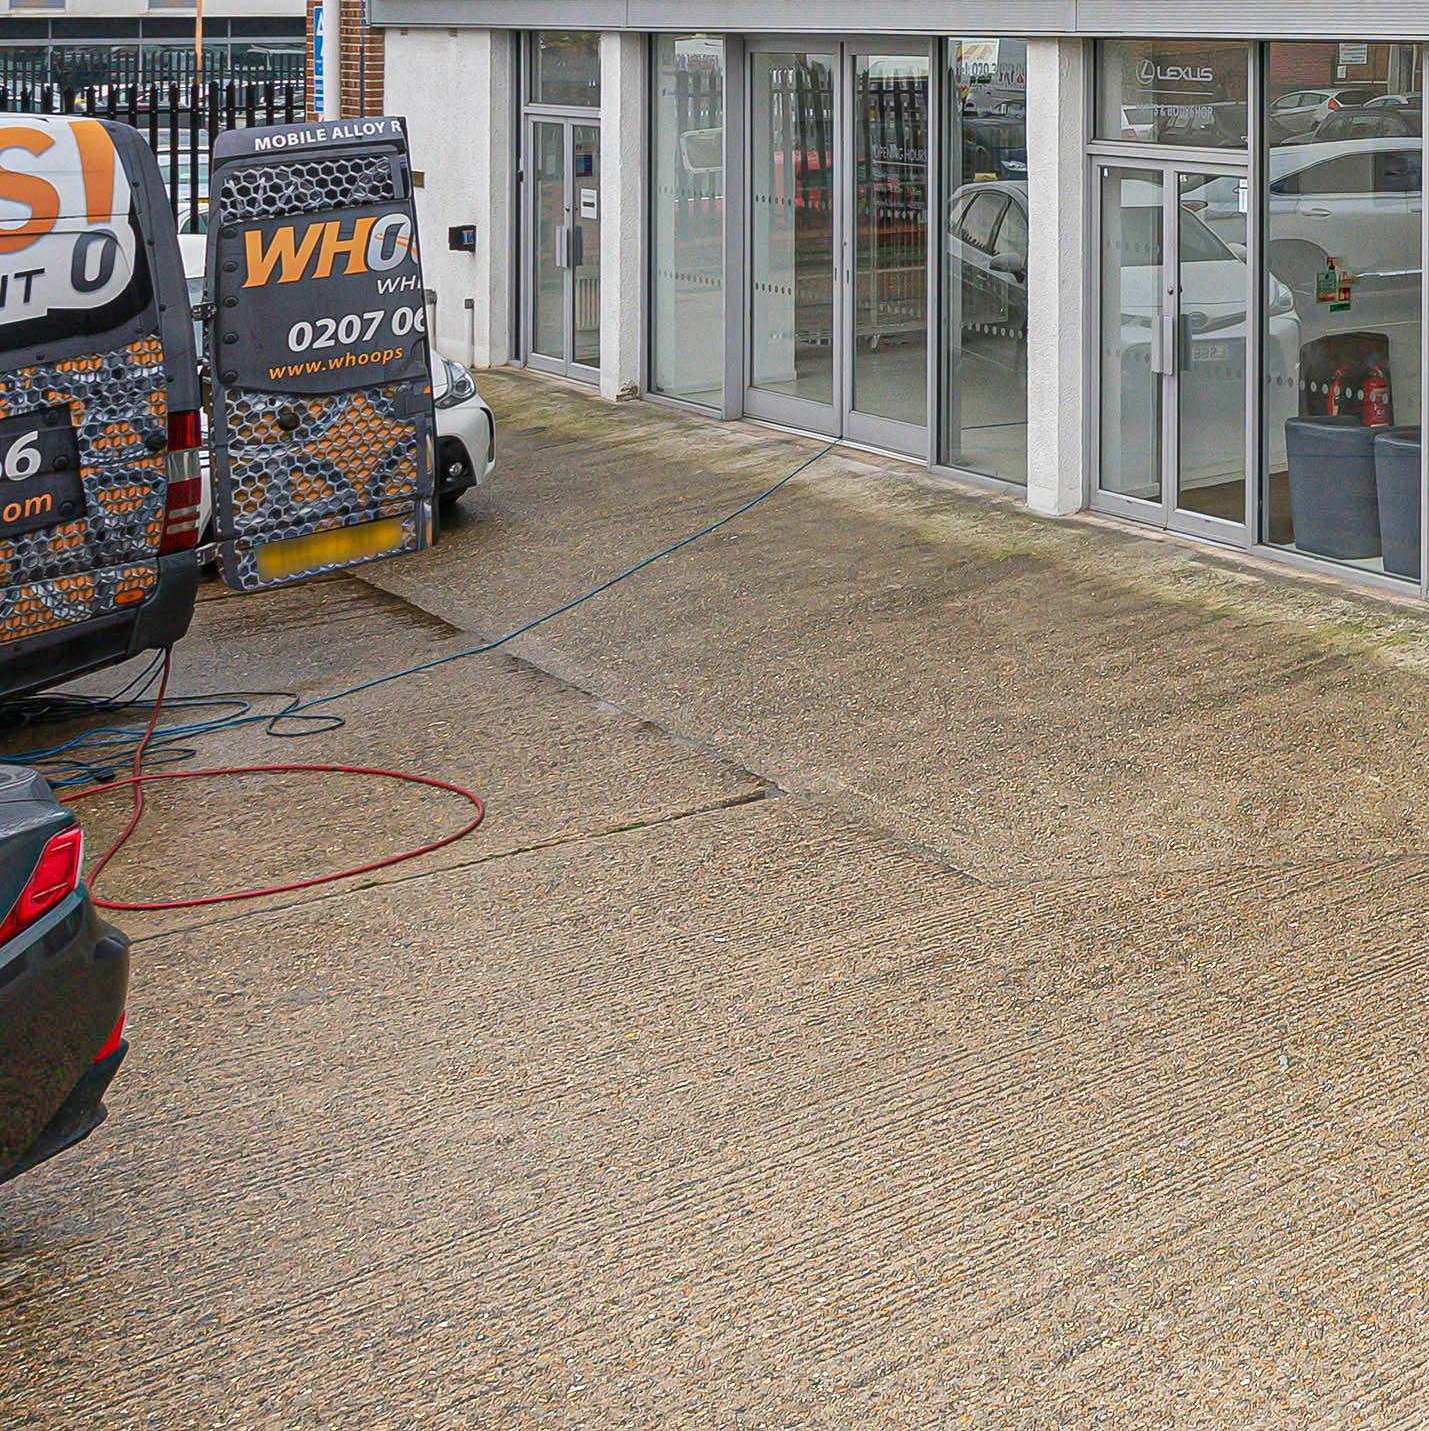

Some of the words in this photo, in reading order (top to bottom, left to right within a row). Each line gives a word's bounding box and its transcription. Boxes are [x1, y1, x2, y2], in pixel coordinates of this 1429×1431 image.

[1157, 66, 1213, 81] LEXUS
[255, 129, 327, 151] MOBILE
[332, 122, 386, 140] ALLOY
[241, 213, 418, 288] WHO
[377, 275, 421, 295] WH
[288, 310, 385, 352] 0207
[268, 347, 403, 380] www.whoops
